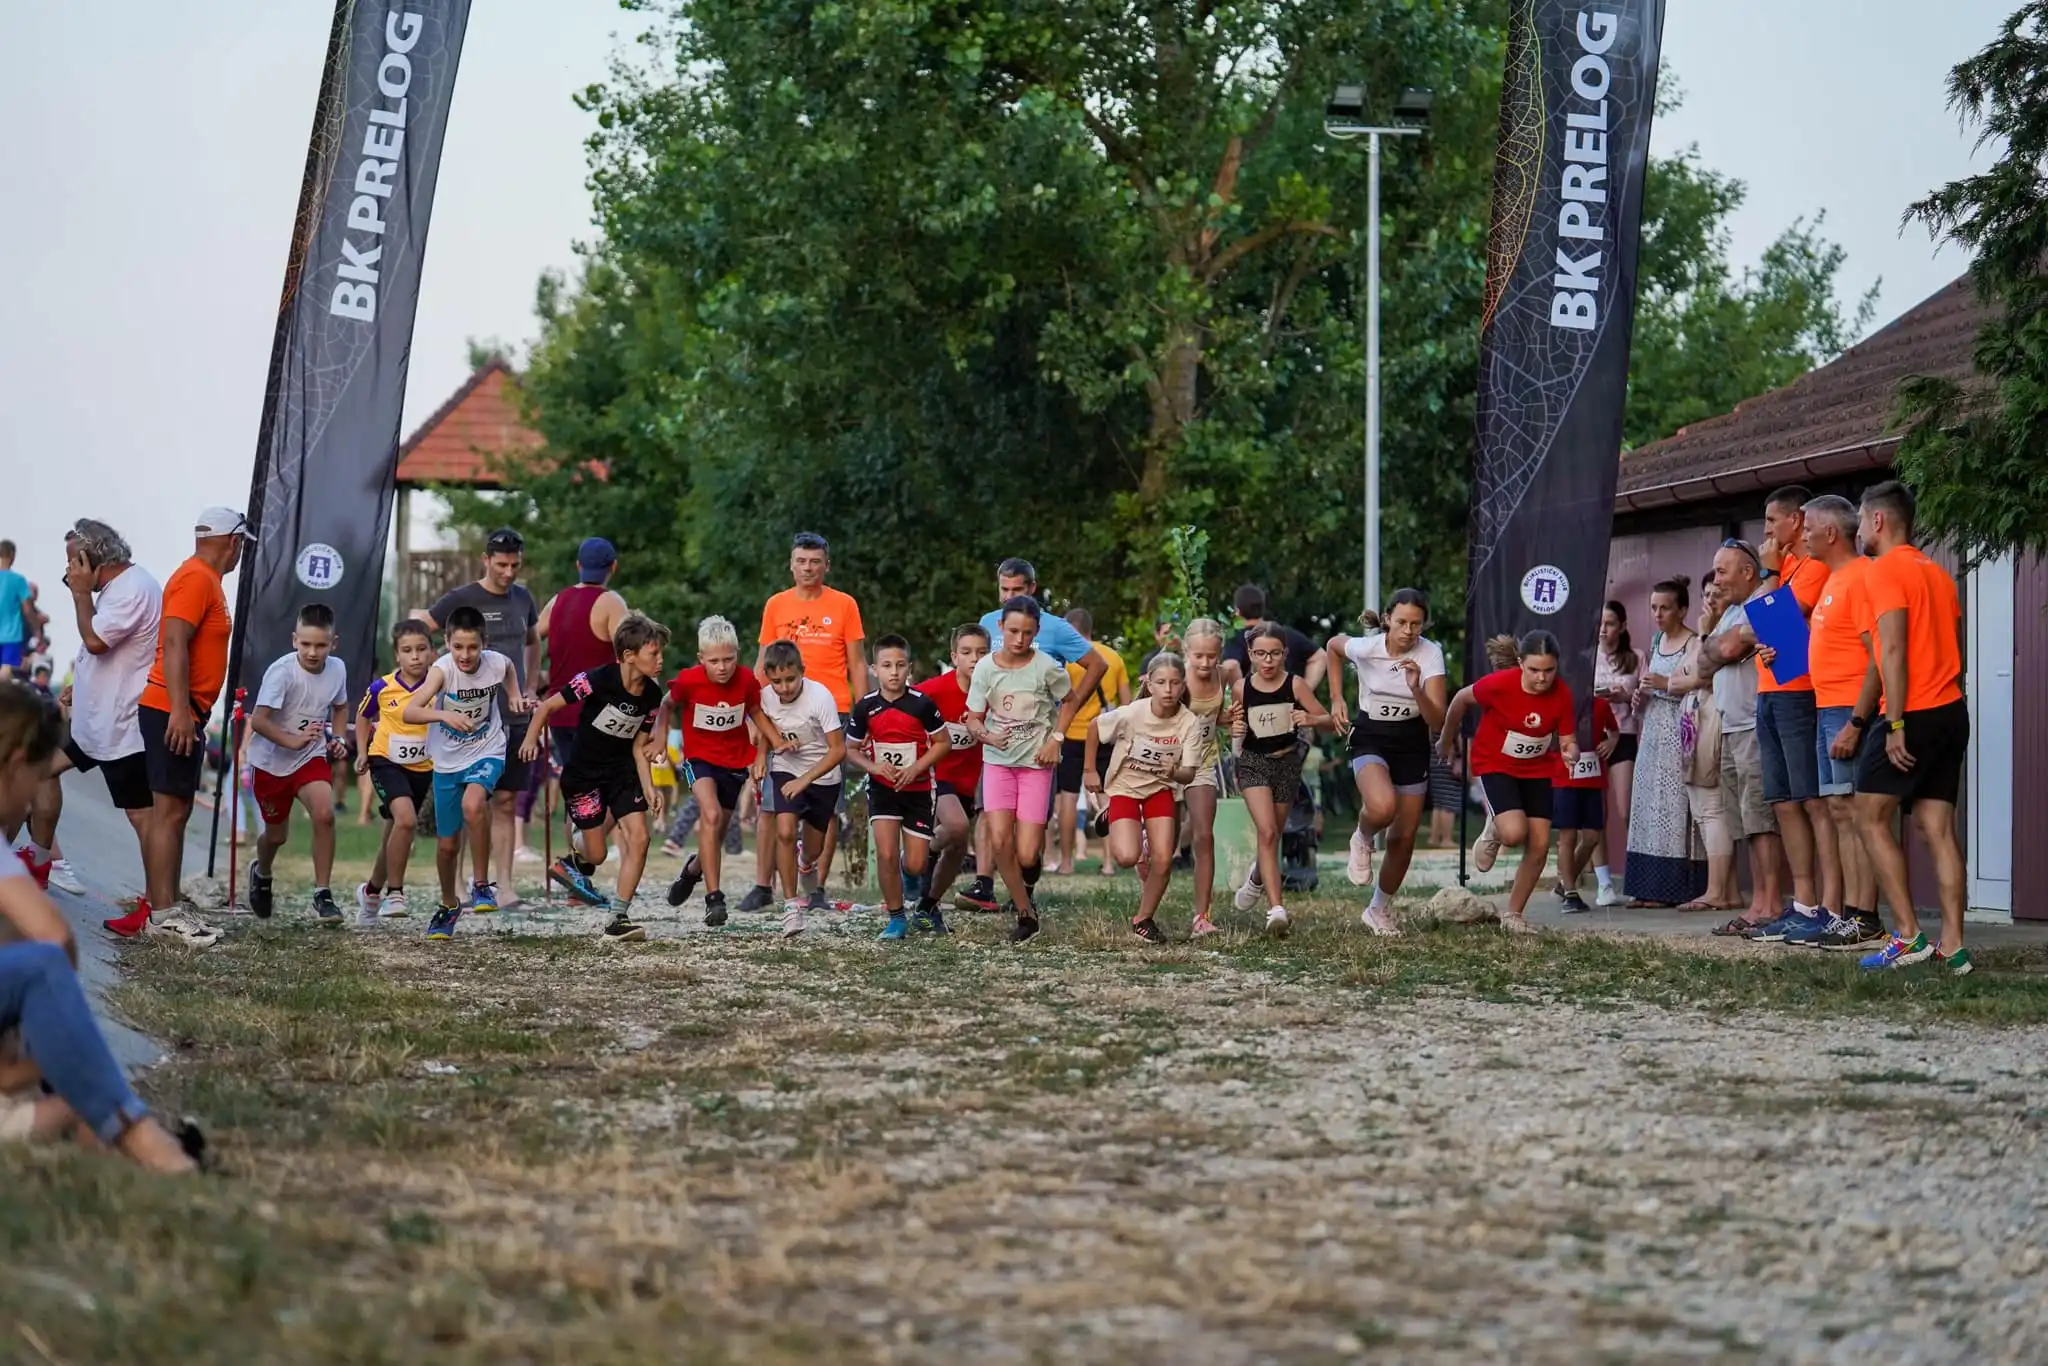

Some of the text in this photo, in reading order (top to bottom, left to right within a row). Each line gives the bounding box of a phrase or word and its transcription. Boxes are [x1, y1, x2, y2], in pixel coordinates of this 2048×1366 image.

[329, 10, 424, 323] BK PRELOG
[1550, 10, 1619, 332] BK PRELOG
[1002, 694, 1015, 712] 6
[453, 707, 482, 719] 32
[1380, 705, 1411, 717] 374
[604, 719, 636, 734] 214
[705, 714, 736, 727] 304
[398, 745, 426, 759] 394
[1514, 743, 1543, 755] 395
[1578, 761, 1598, 773] 391
